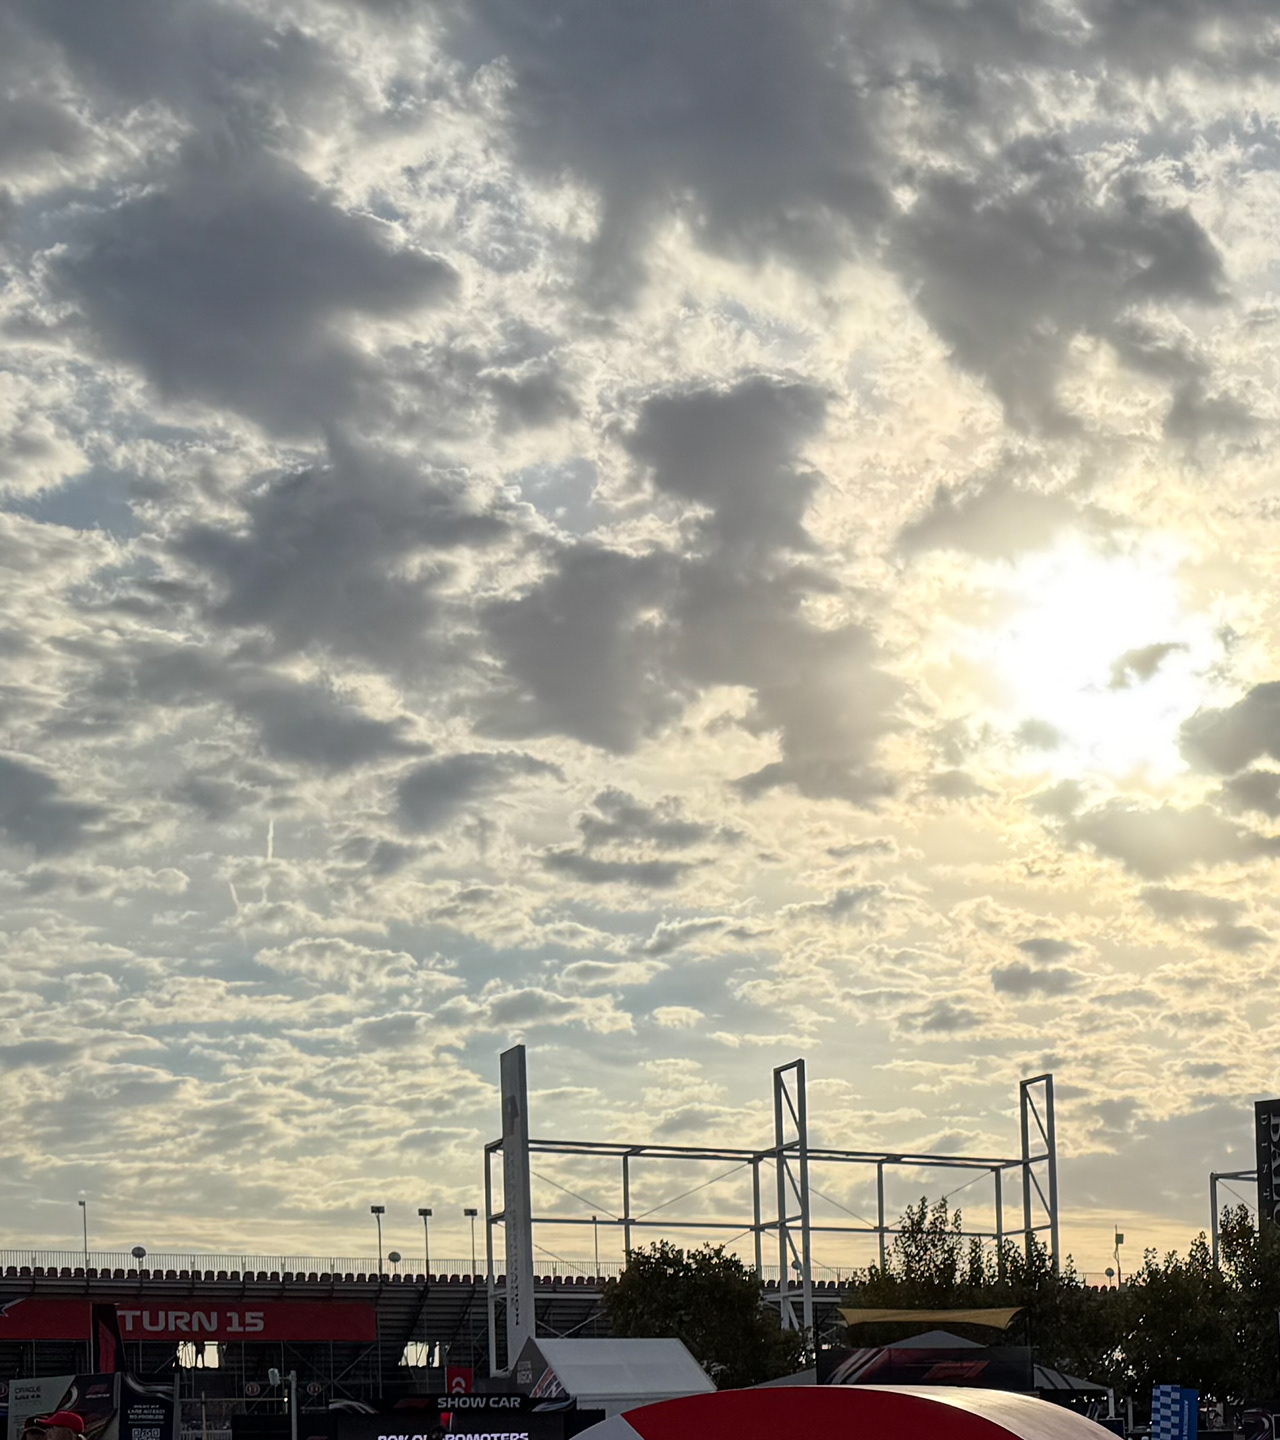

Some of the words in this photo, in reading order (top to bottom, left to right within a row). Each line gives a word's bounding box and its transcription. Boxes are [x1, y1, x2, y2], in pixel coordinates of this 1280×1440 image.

[116, 1309, 217, 1332] TURN
[226, 1311, 264, 1333] 15
[437, 1397, 486, 1408] SHOW
[489, 1397, 520, 1408] CAR
